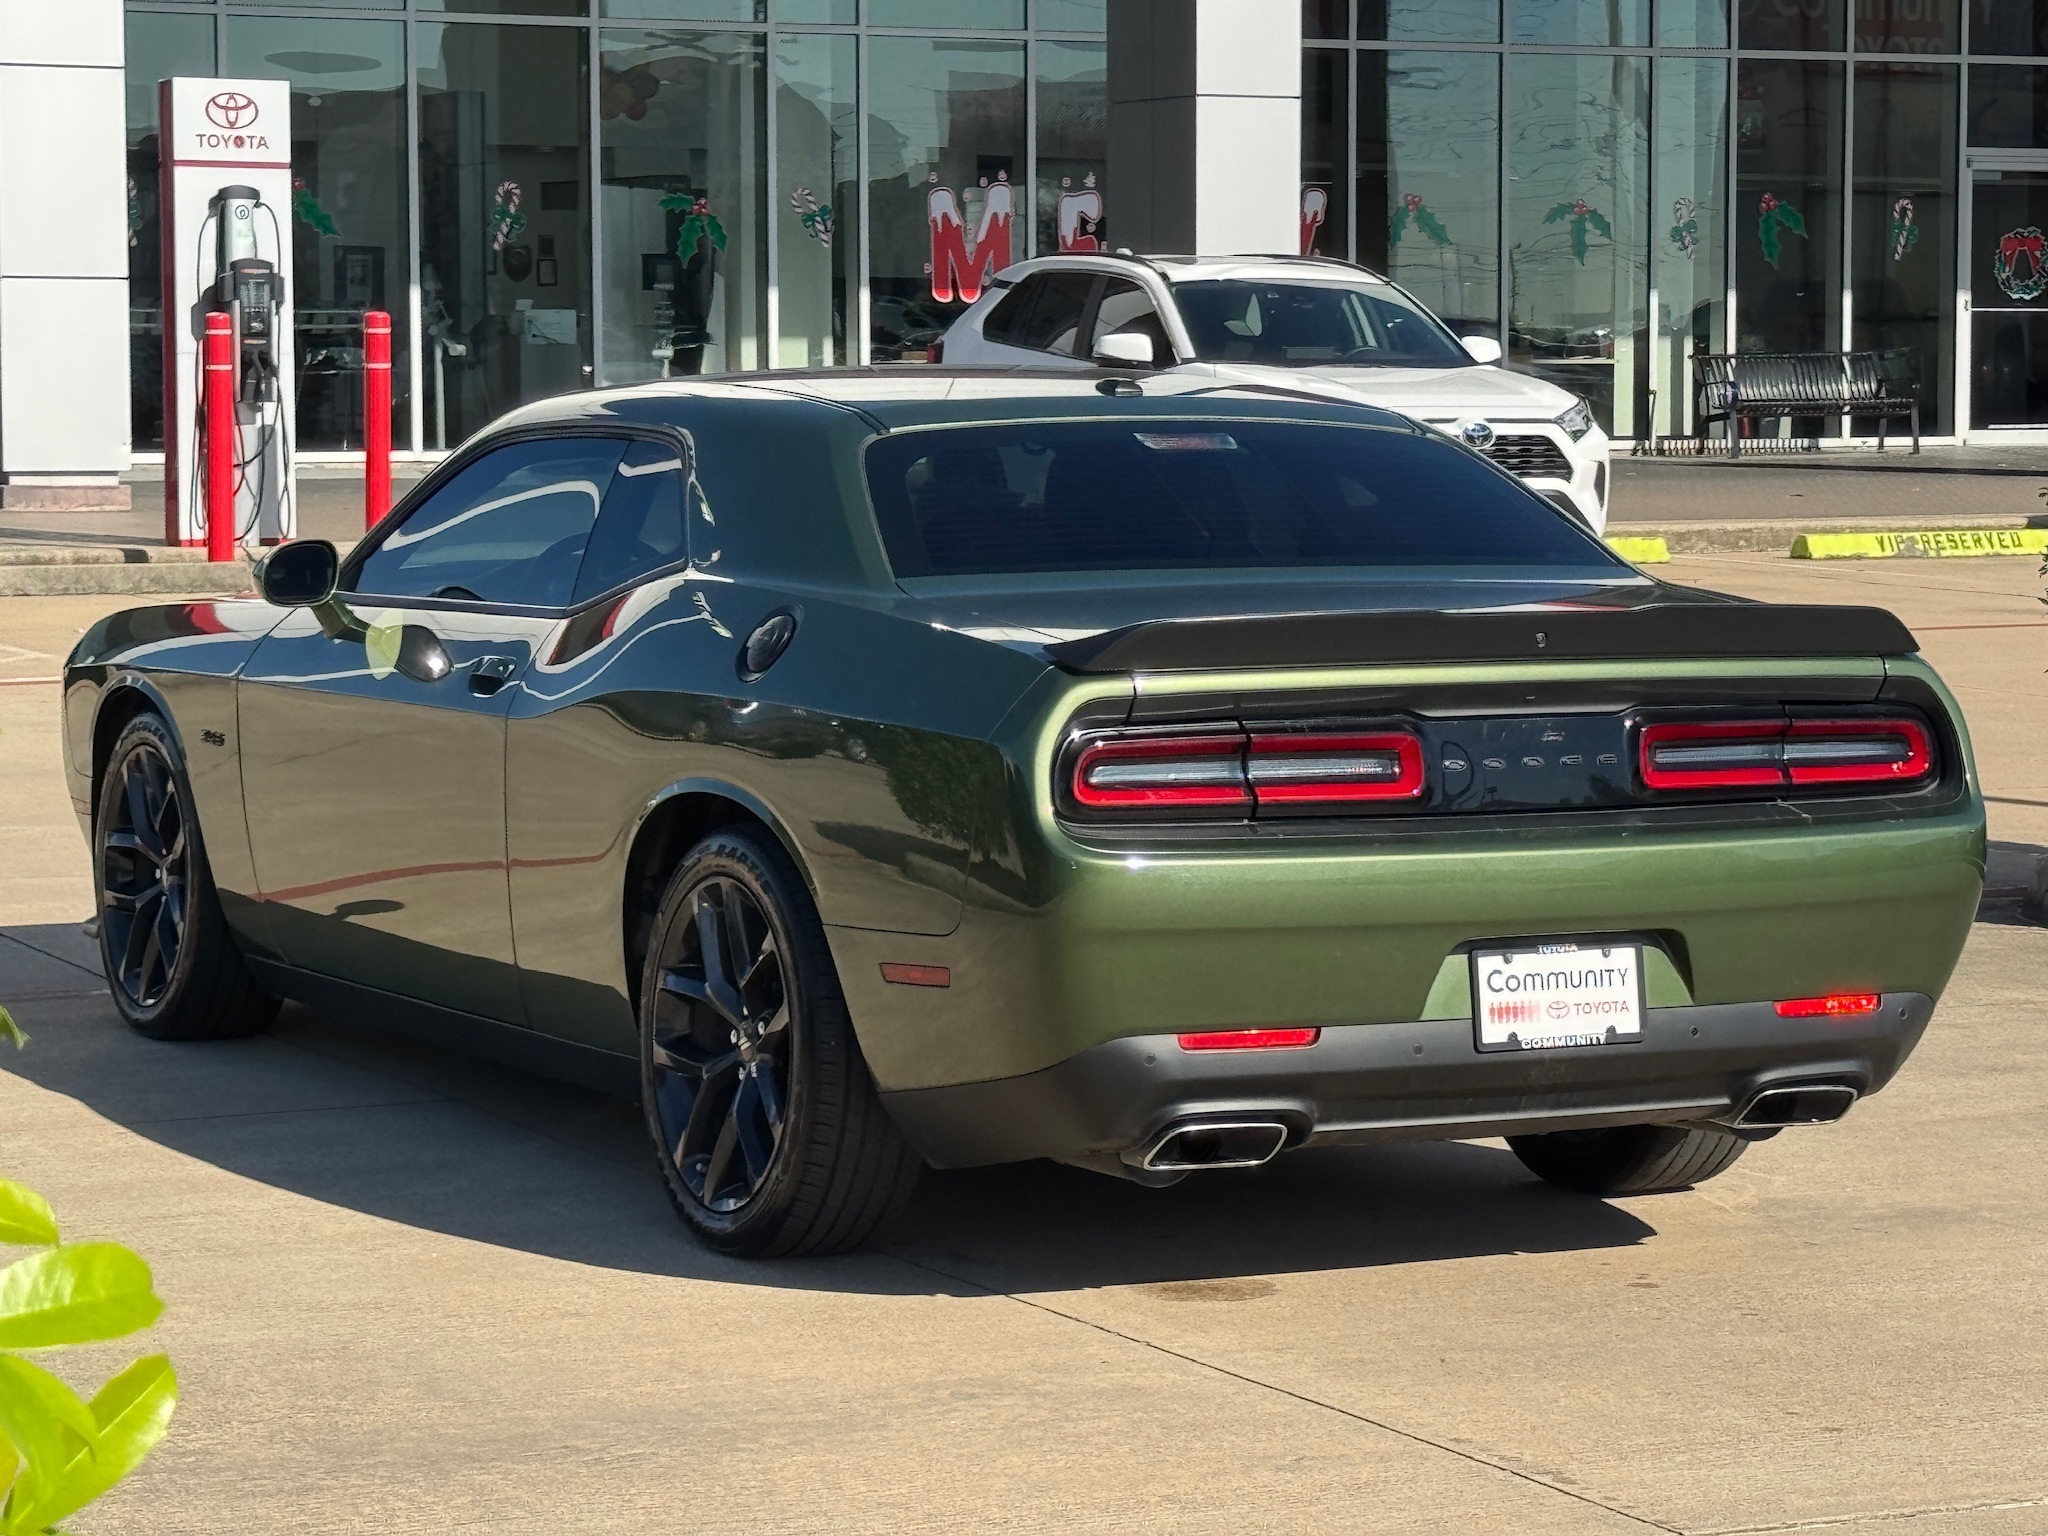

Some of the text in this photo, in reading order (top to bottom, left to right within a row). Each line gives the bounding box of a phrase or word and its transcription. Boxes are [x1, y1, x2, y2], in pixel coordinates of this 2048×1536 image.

[195, 133, 270, 150] TOYOTA
[1919, 531, 2023, 554] RESERVED
[1442, 753, 1618, 772] DODGE
[1573, 1000, 1630, 1016] TOYOTA
[1520, 1033, 1608, 1050] COMMUNITY
